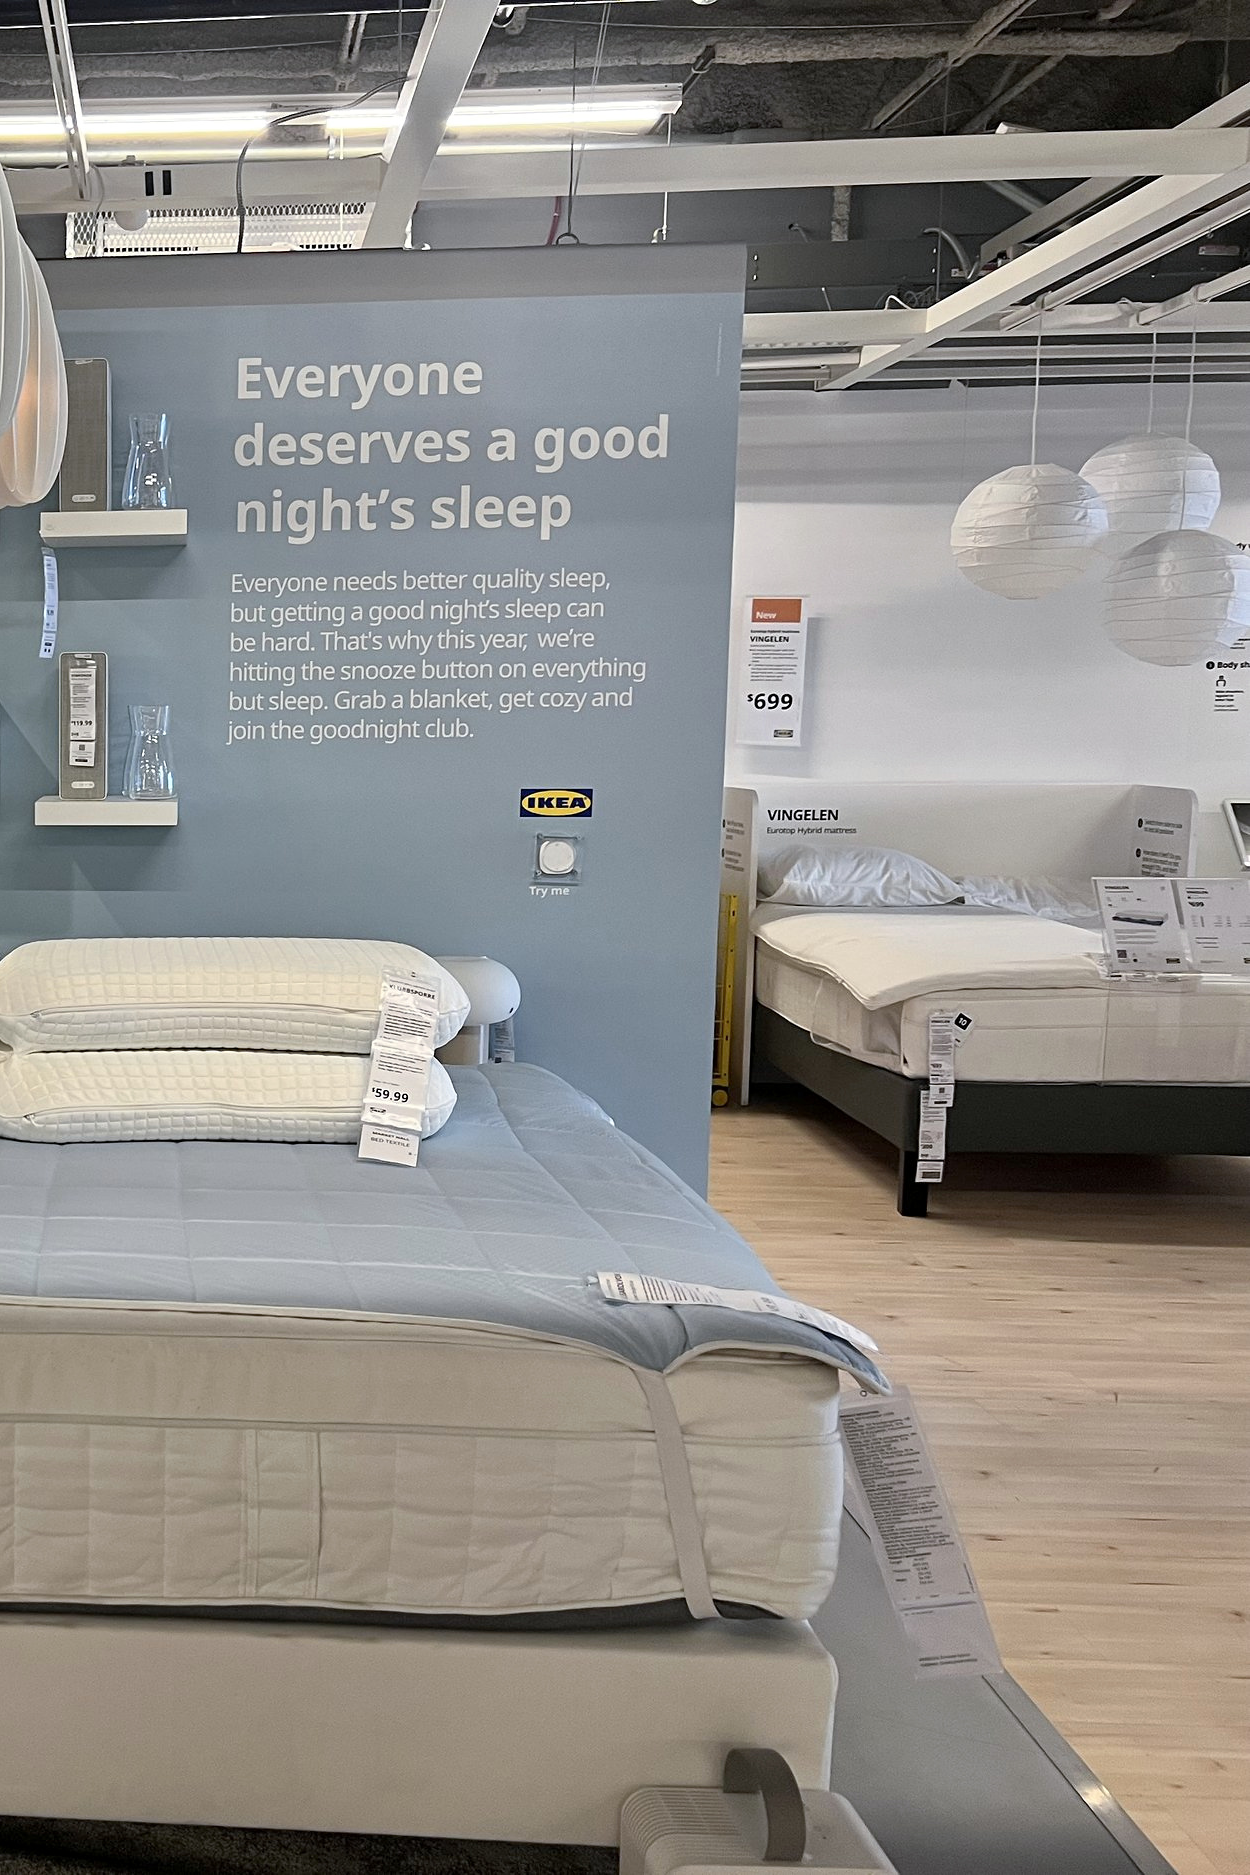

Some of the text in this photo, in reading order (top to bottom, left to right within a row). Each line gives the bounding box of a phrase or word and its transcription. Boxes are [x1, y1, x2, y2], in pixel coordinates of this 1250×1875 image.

[237, 357, 483, 410] Everyone
[234, 413, 669, 474] deserves a good
[237, 484, 572, 545] night’s sleep
[231, 567, 611, 599] Everyone needs better quality sleep,
[230, 602, 267, 623] but
[270, 601, 346, 628] getting
[350, 605, 363, 621] a
[368, 600, 426, 627] good
[504, 597, 561, 624] sleep
[566, 601, 605, 619] can
[755, 611, 777, 619] New
[230, 631, 256, 653] be
[261, 630, 316, 652] hard.
[387, 628, 433, 656] why
[436, 628, 476, 651] this
[479, 633, 529, 655] year,
[750, 635, 790, 643] VINGELEN
[229, 656, 648, 687] hitting the snooze button on everything
[1217, 661, 1238, 670] Body
[229, 686, 634, 716] but sleep. Grab a blanket, get cozy and
[747, 693, 793, 710] $699
[225, 717, 475, 746] join the goodnight club.
[527, 797, 587, 808] IKEA
[767, 809, 839, 821] VINGELEN
[766, 826, 796, 835] Eurotop
[797, 826, 823, 835] Hybrid
[529, 886, 570, 898] Try me
[958, 1017, 968, 1026] 10
[371, 1087, 409, 1103] $59.99
